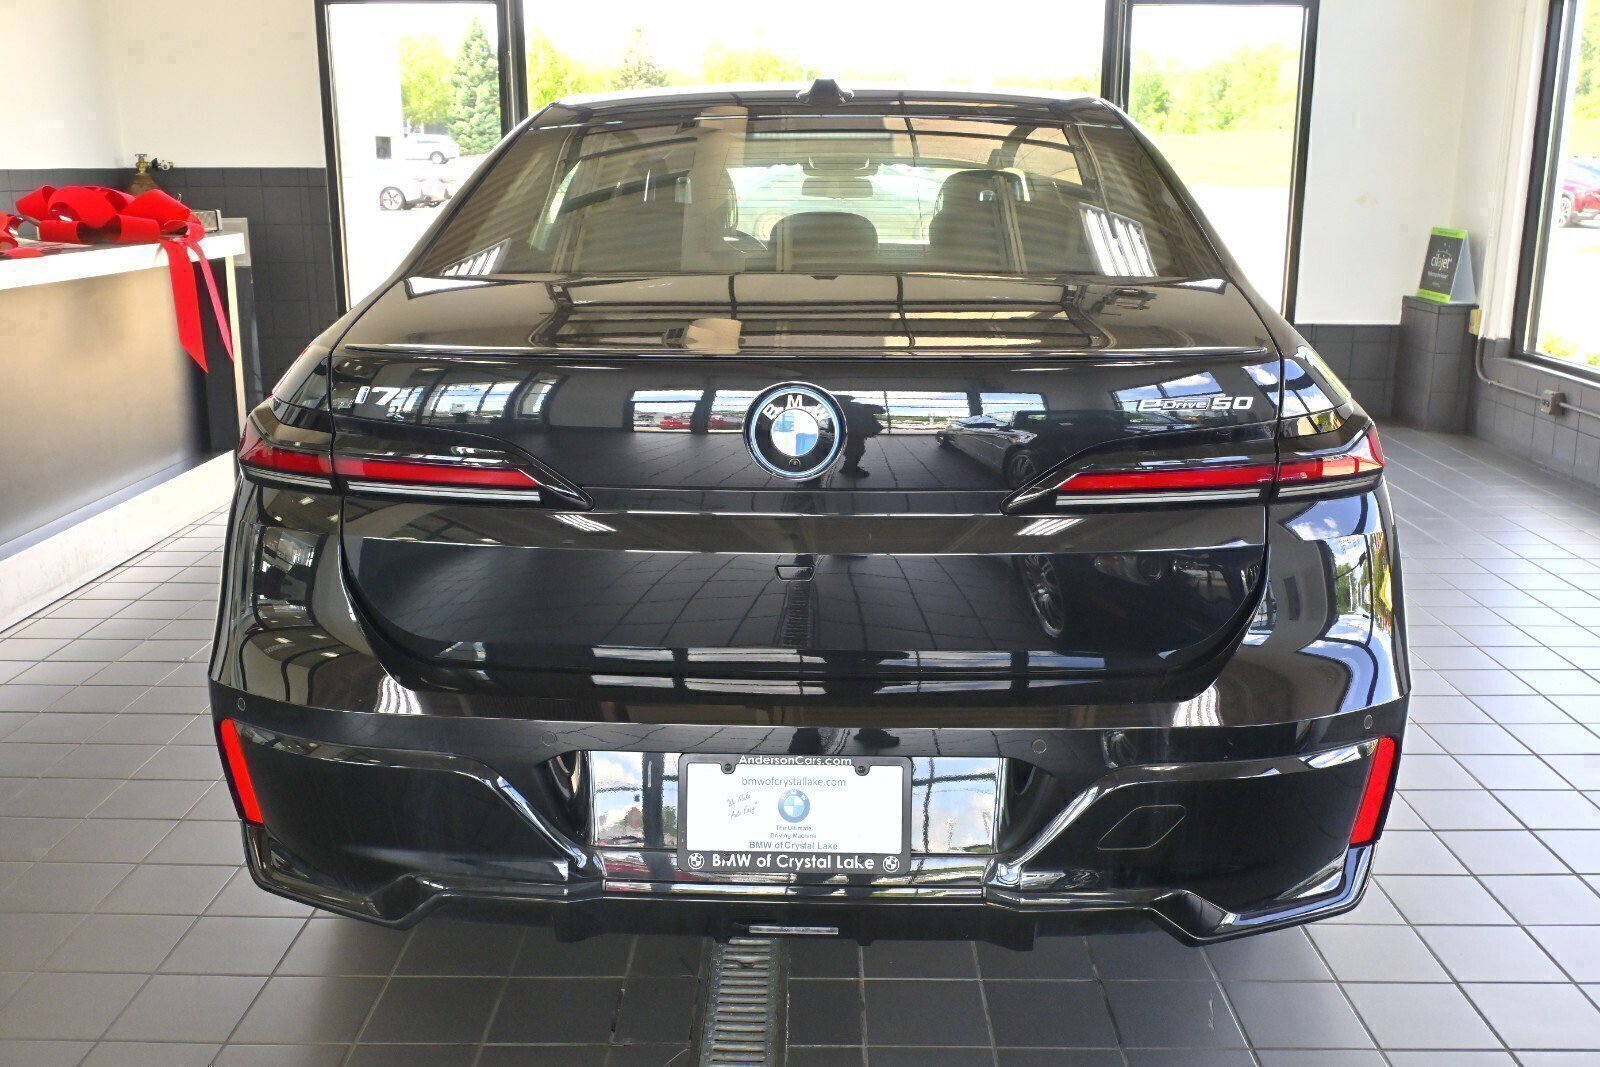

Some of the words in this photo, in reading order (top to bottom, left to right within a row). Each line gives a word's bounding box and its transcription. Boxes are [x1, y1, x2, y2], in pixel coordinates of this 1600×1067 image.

[762, 394, 829, 420] BMW
[739, 755, 852, 766] AndersonCars.com
[742, 777, 846, 787] bmwofcrystallake.com
[749, 841, 772, 850] BMW
[774, 841, 784, 850] of
[784, 841, 815, 852] Crystal
[817, 841, 839, 851] Lake
[712, 853, 751, 867] BMW
[756, 854, 772, 868] of
[776, 855, 831, 870] Crystal
[836, 856, 875, 869] Lake
